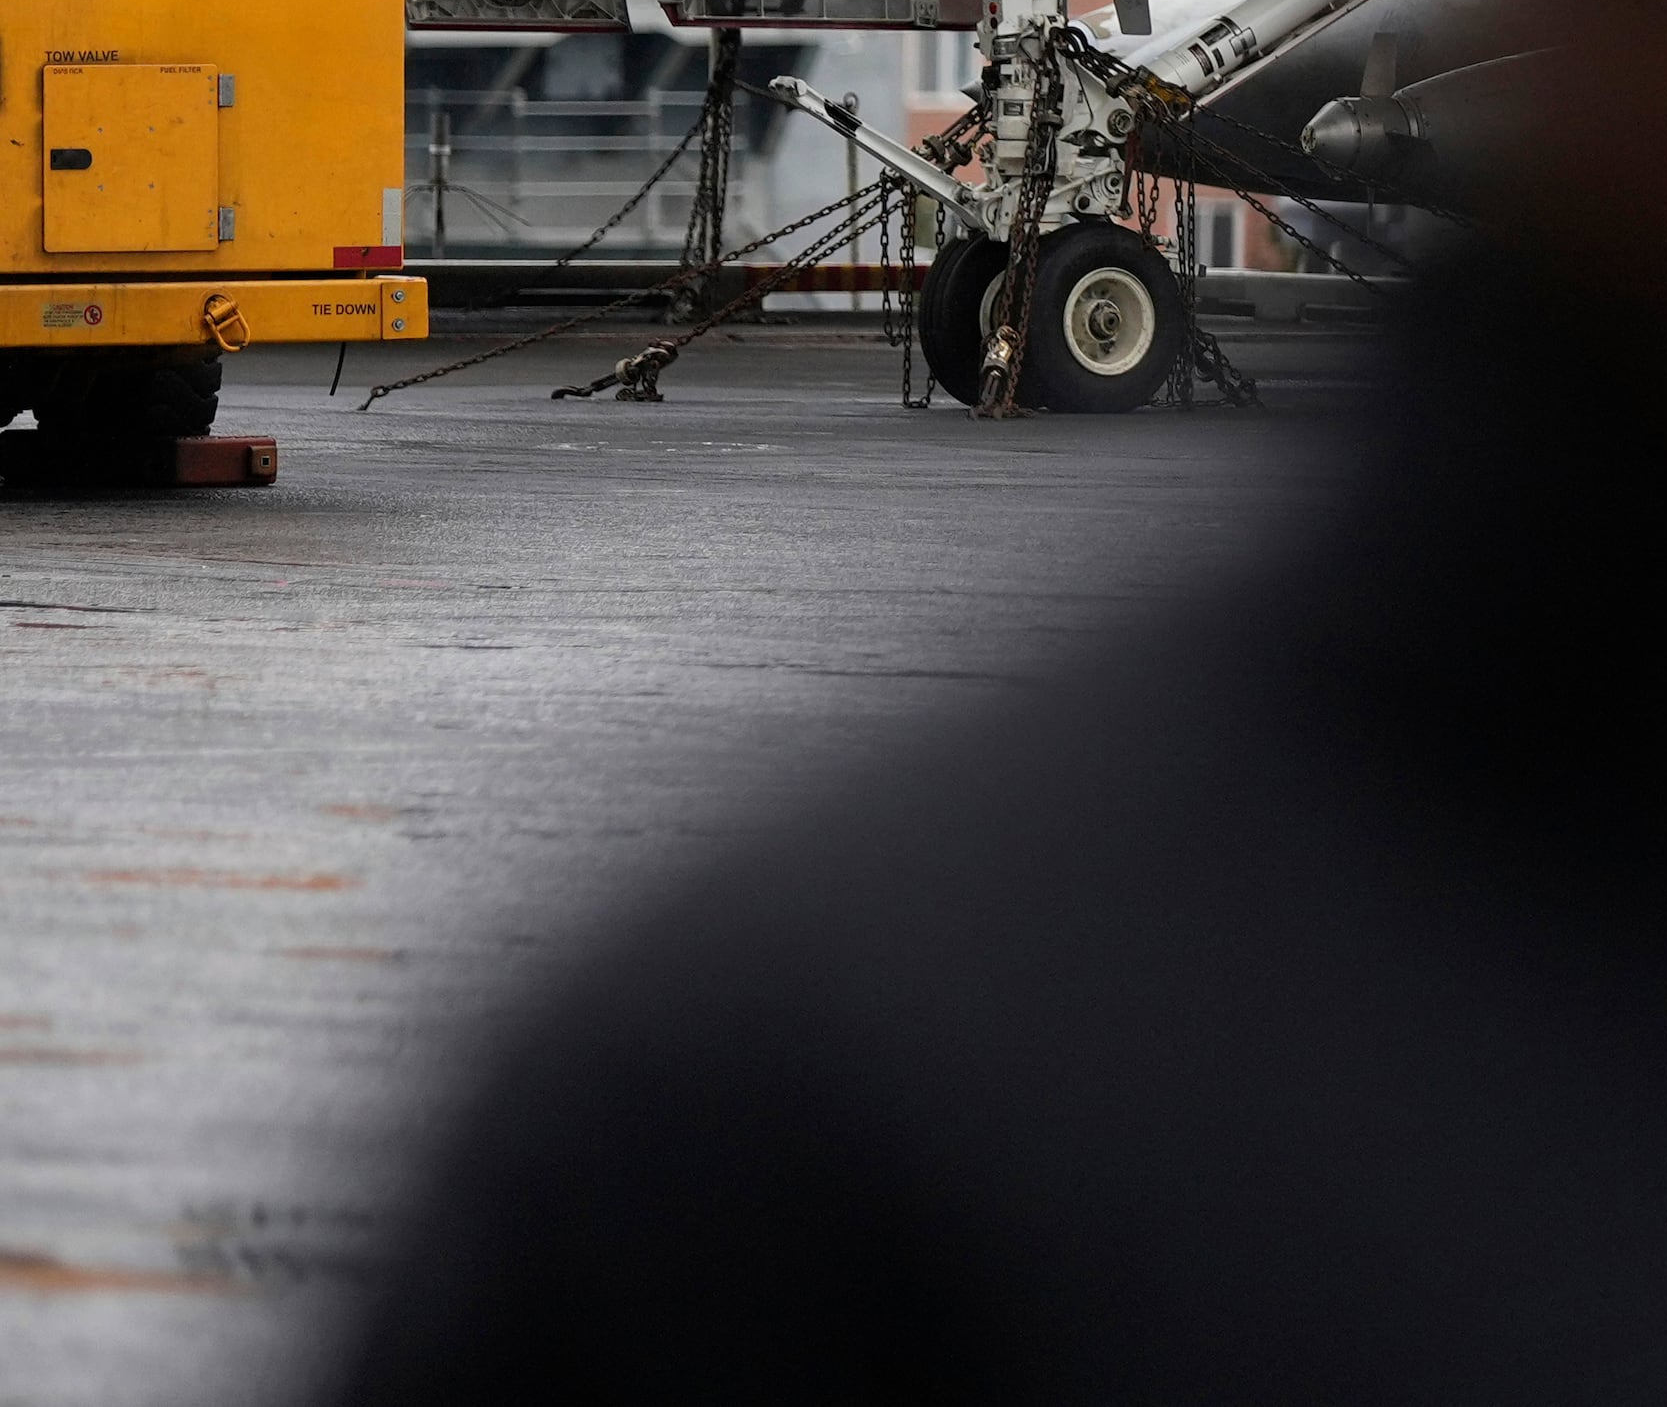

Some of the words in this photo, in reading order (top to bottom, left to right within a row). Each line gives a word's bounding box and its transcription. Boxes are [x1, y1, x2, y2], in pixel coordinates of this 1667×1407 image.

[45, 50, 75, 63] TOW
[78, 50, 119, 62] VALVE
[312, 304, 332, 315] TIE
[335, 304, 376, 315] DOWN
